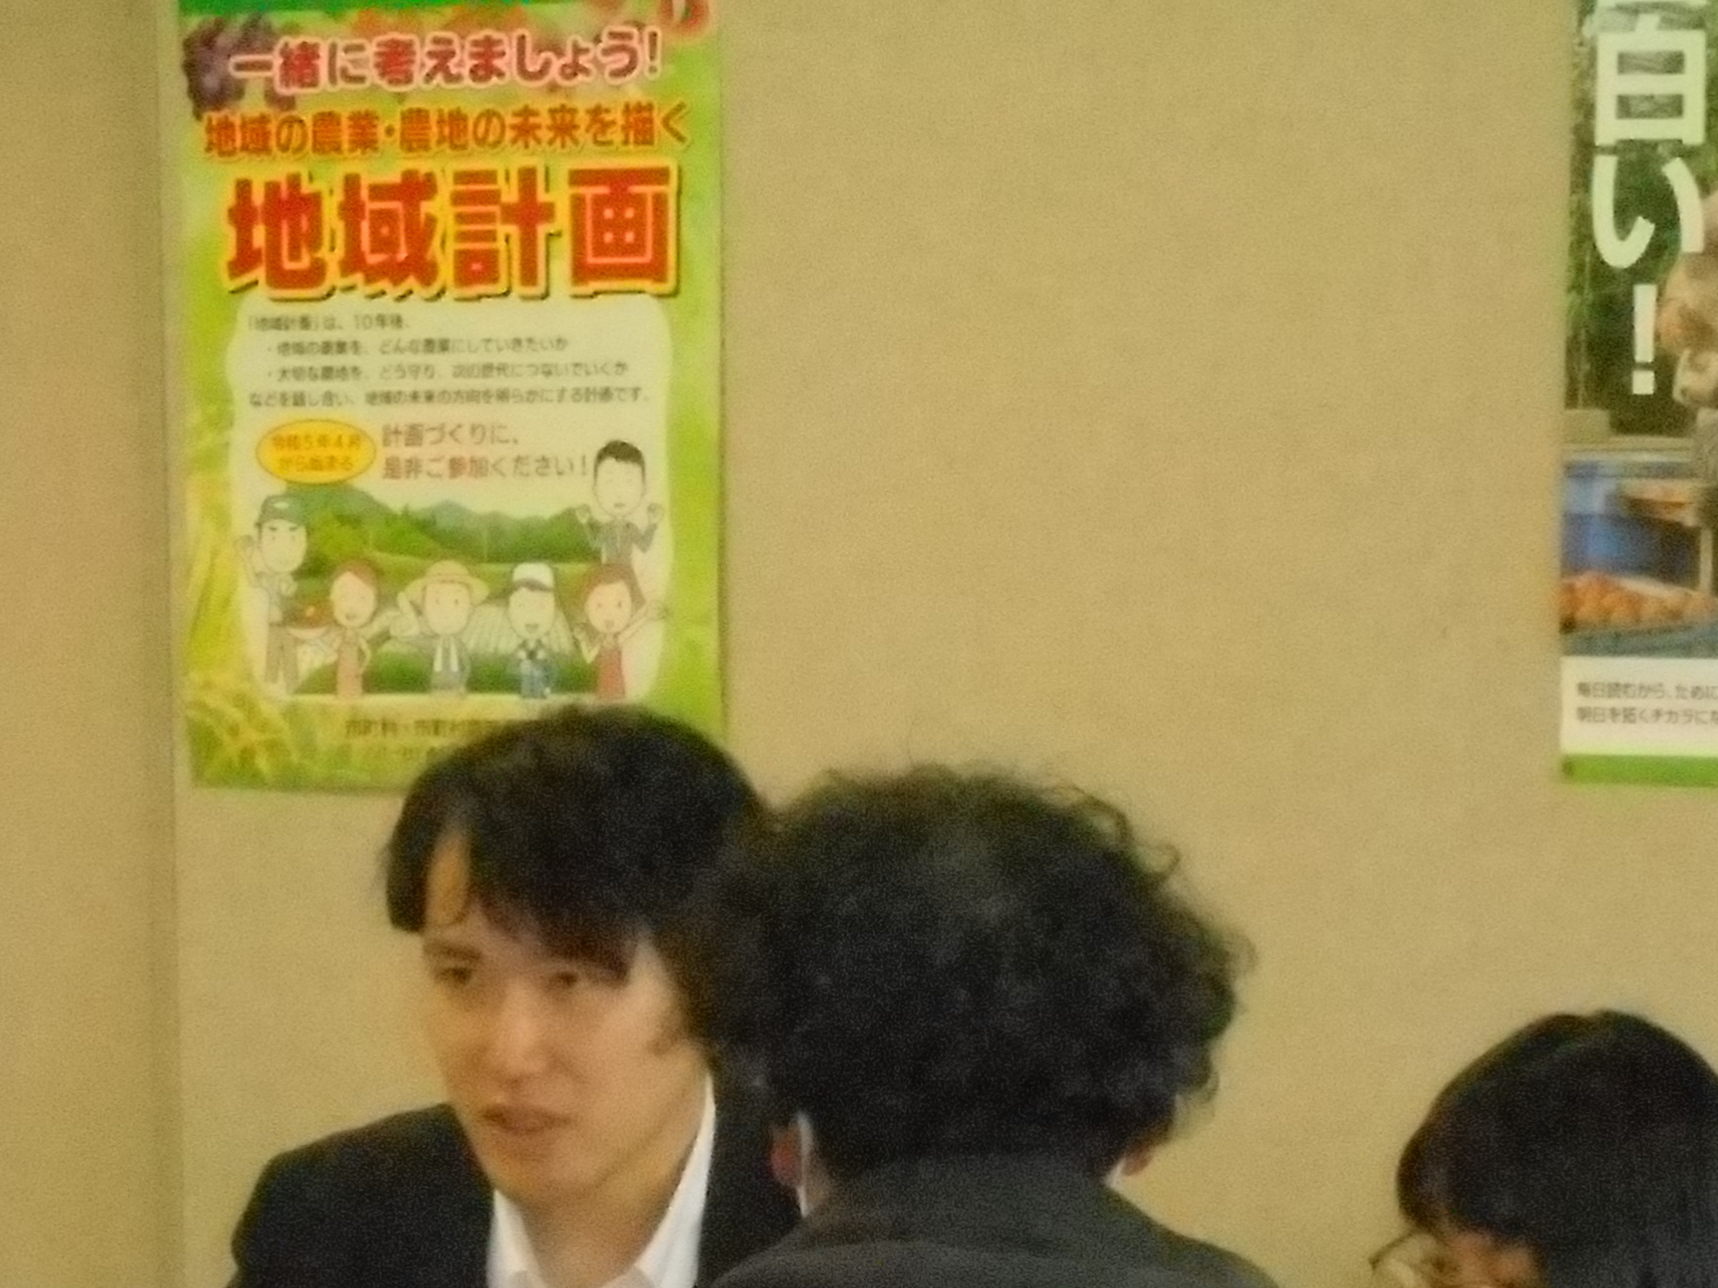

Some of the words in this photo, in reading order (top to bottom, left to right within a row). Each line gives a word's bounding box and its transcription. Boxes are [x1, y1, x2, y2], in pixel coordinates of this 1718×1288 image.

[232, 29, 661, 88] 一緒に考えましょう！
[204, 101, 689, 155] 地域の農業・農地の未来を描く
[227, 165, 671, 291] 地域計画
[1591, 0, 1708, 396] 白い！
